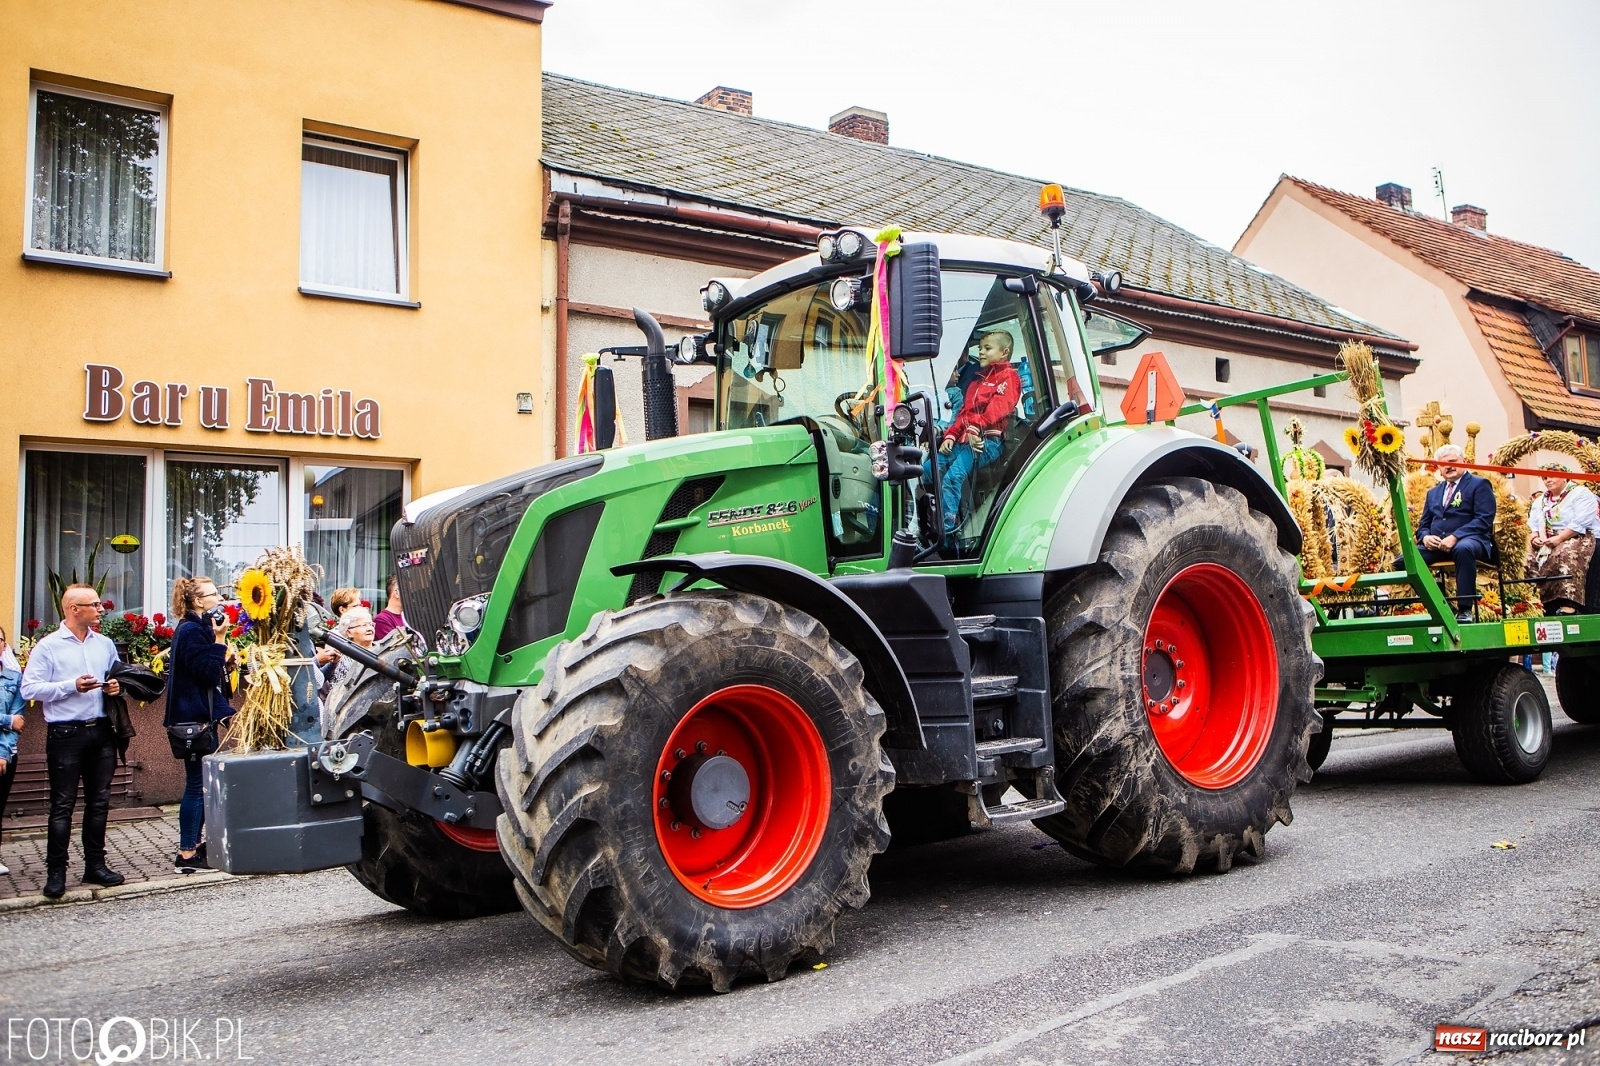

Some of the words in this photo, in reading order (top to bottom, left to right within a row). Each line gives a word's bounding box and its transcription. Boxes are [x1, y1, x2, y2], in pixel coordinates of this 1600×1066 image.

[82, 362, 189, 427] Bar
[198, 384, 230, 430] u
[245, 376, 382, 439] Emila
[731, 518, 790, 537] Korbanek
[766, 500, 797, 516] 826
[738, 647, 855, 743] MICHELIN
